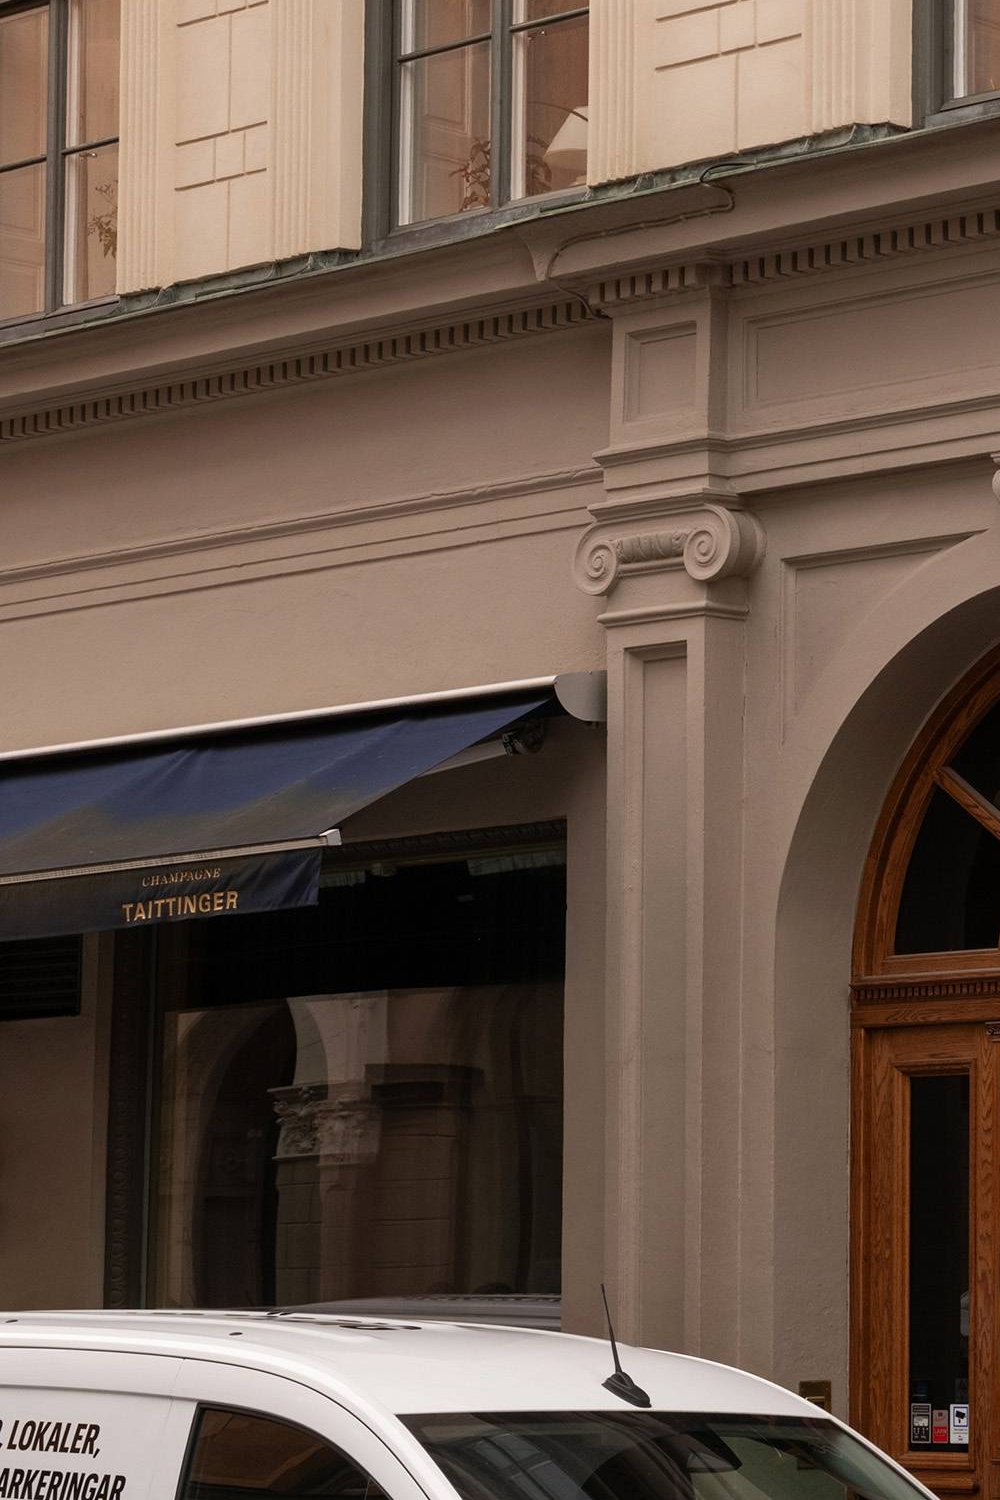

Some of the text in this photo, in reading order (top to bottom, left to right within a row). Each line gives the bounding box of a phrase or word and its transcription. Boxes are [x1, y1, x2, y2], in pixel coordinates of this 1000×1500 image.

[142, 868, 221, 887] CHAMPAGNE
[122, 891, 239, 922] TAITTINGER
[7, 1420, 101, 1458] LOKALER,
